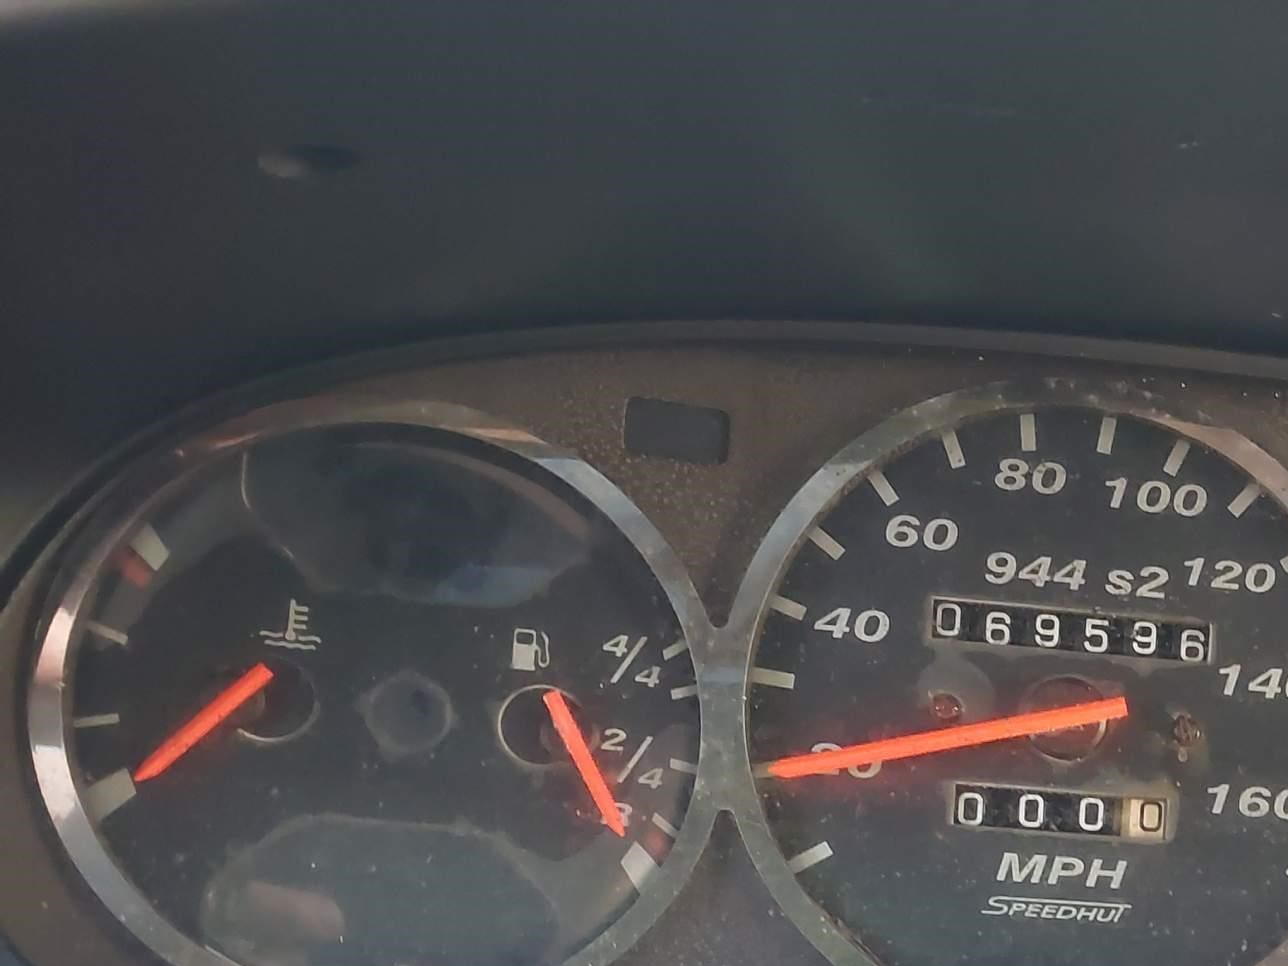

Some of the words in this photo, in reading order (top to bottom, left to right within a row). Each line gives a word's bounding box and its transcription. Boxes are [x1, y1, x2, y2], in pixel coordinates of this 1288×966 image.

[994, 458, 1066, 495] 80
[1105, 477, 1207, 517] 100
[885, 515, 959, 551] 60
[984, 552, 1087, 591] 944
[1184, 558, 1276, 593] 120
[814, 608, 890, 642] 40
[996, 852, 1128, 889] MPH
